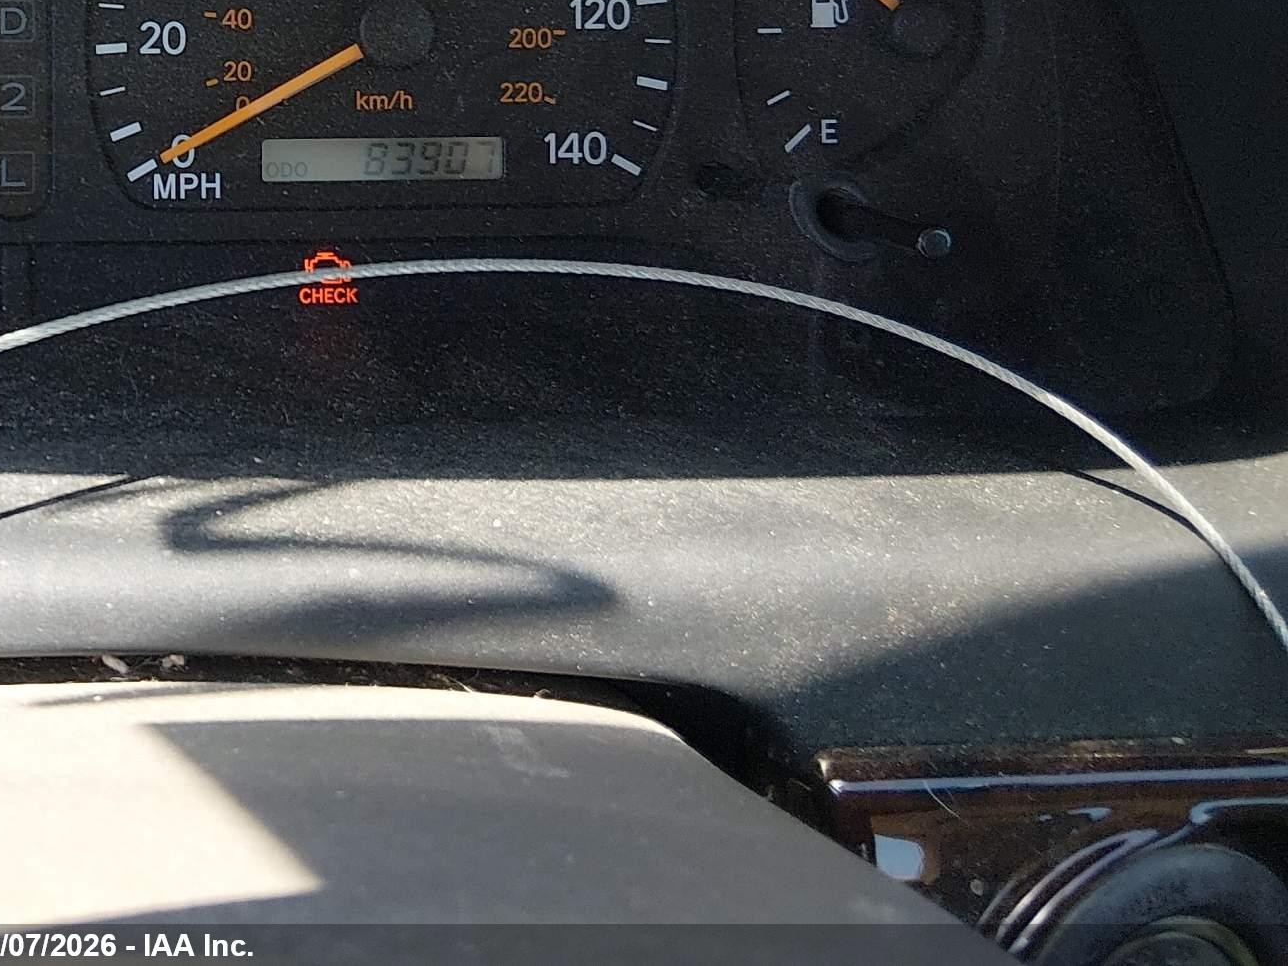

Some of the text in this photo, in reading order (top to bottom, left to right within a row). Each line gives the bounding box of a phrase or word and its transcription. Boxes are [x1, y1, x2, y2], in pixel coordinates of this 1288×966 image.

[0, 8, 27, 35] D
[222, 9, 252, 30] 40
[140, 22, 186, 56] 20
[508, 28, 551, 49] 200
[224, 62, 252, 82] 20
[1, 83, 26, 110] 2
[355, 91, 413, 110] km/h
[500, 83, 542, 104] 220
[821, 120, 838, 143] E
[172, 134, 195, 168] 0
[544, 132, 606, 164] 140
[0, 160, 25, 186] L
[266, 162, 308, 178] ODO
[154, 173, 220, 199] MPH
[299, 288, 358, 303] CHECK
